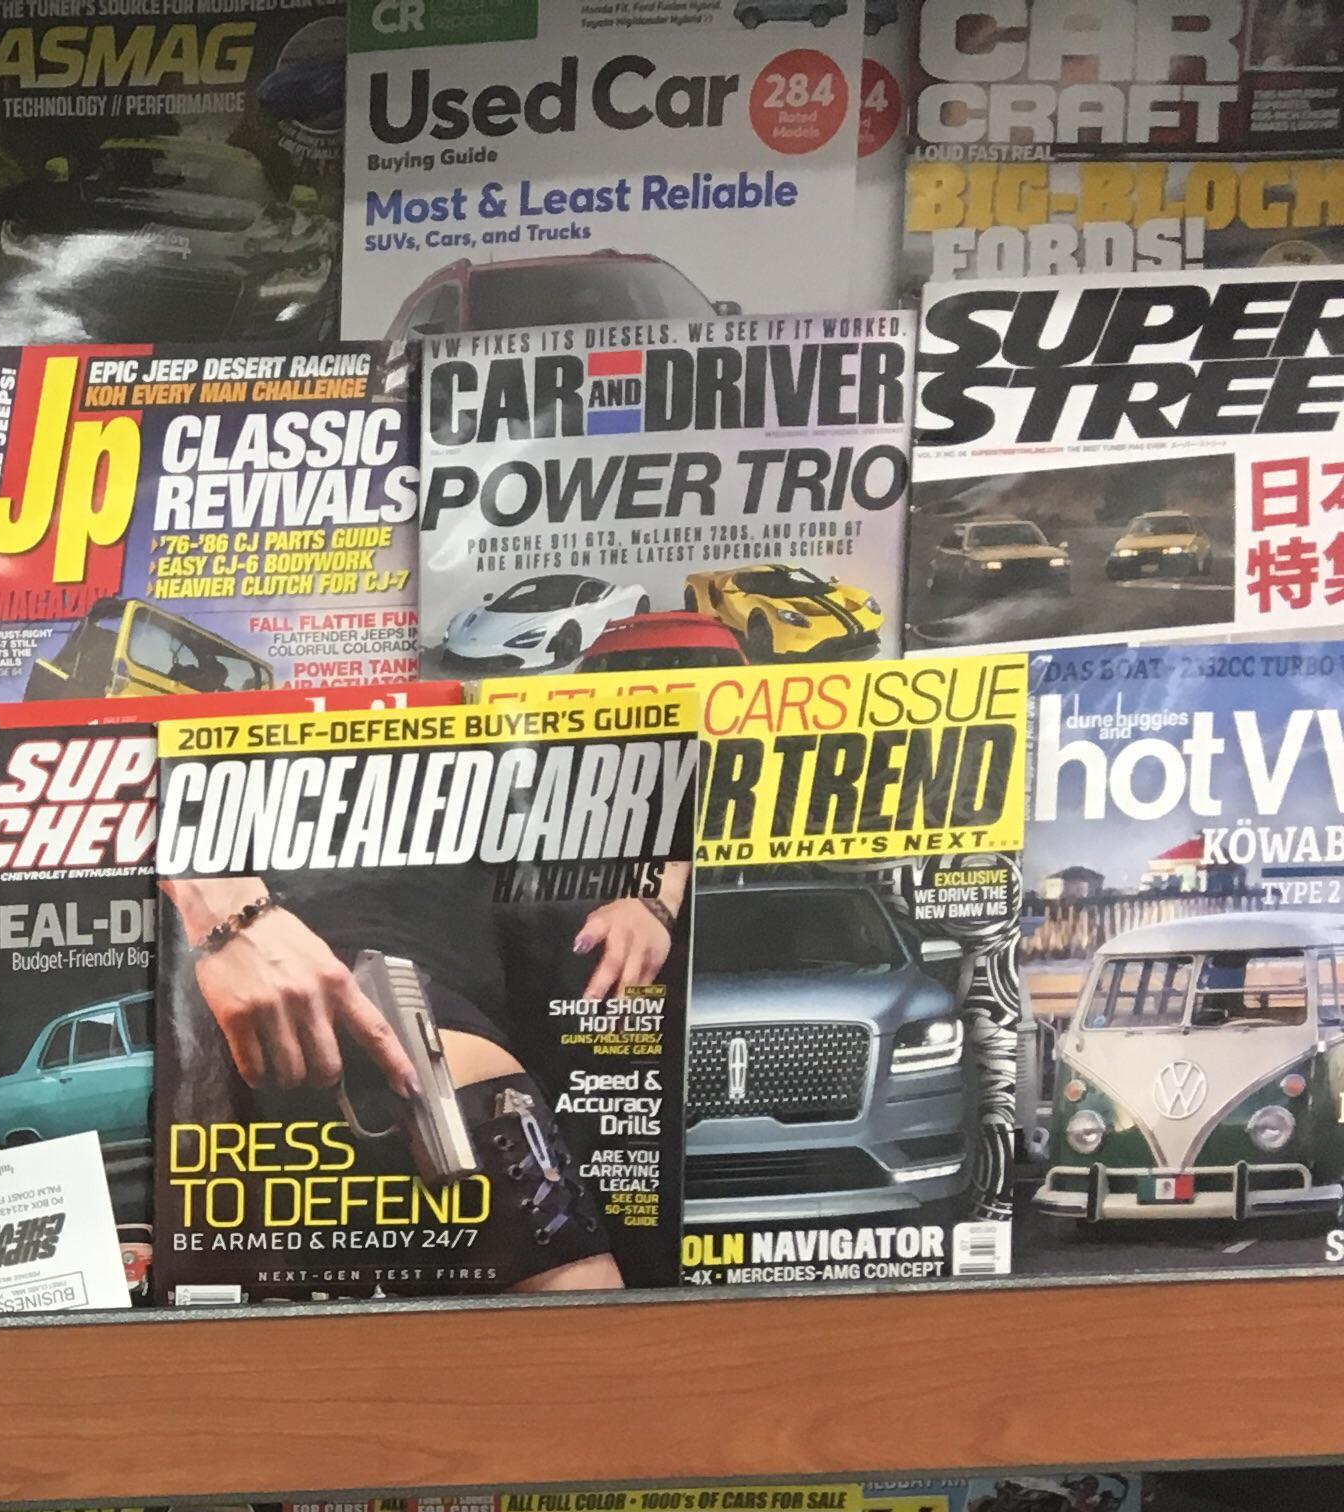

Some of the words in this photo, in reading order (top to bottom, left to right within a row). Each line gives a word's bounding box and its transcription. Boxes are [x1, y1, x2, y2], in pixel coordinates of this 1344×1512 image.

[370, 56, 580, 144] Used
[593, 53, 740, 131] Car
[367, 150, 433, 171] Buying
[440, 146, 497, 168] Guide
[365, 188, 466, 228] Most
[480, 182, 510, 216] &
[520, 178, 632, 216] Least
[641, 172, 797, 211] Reliable
[365, 233, 421, 252] SUVs,
[426, 231, 476, 249] Cars,
[481, 228, 520, 245] and
[527, 223, 591, 242] Trucks
[162, 409, 401, 472] CLASSIC
[153, 466, 418, 531] REVIVALS
[180, 726, 240, 749] 2017
[247, 718, 457, 746] SELF-DEFENSE
[463, 711, 586, 736] BUYER'S
[593, 704, 681, 730] GUIDE
[570, 1071, 632, 1092] Speed
[556, 1094, 662, 1119] Accuracy
[601, 1115, 661, 1136] Drills
[170, 1124, 354, 1172] DRESS
[171, 1180, 252, 1228] TO
[263, 1176, 492, 1226] DEFEND
[752, 1226, 944, 1264] NAVIGATOR
